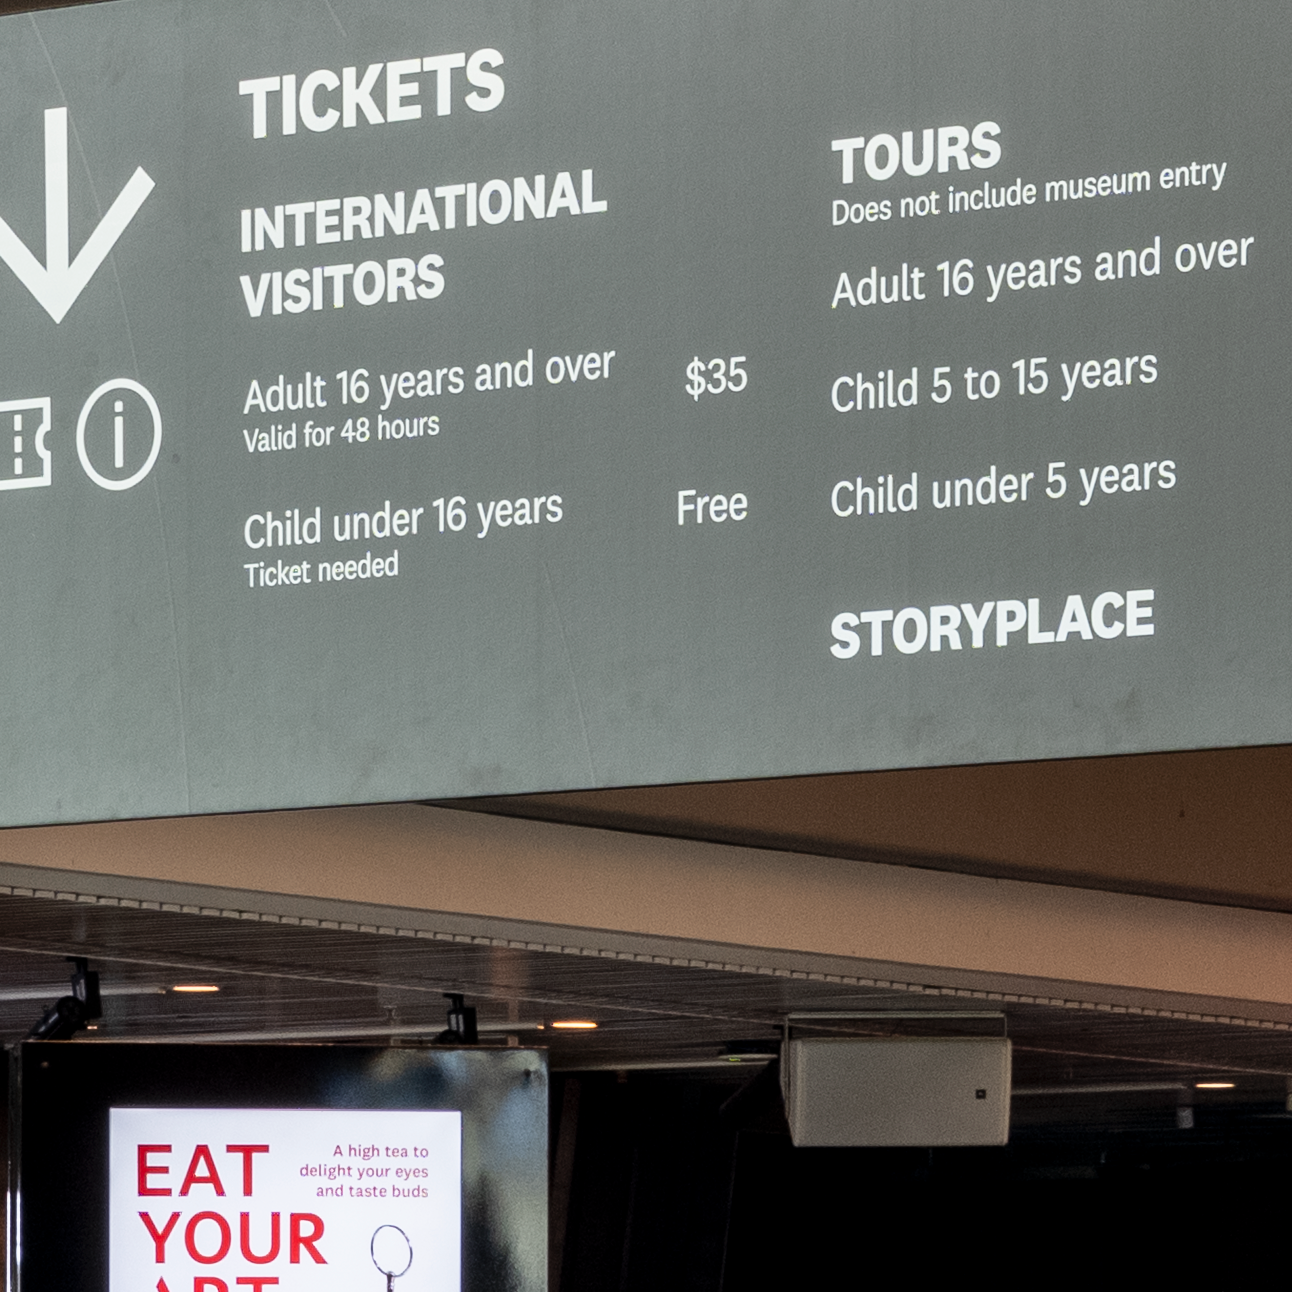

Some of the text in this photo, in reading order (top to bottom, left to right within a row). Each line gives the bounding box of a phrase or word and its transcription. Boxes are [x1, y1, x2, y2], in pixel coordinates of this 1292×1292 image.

[238, 47, 505, 139] TICKETS
[831, 121, 1002, 184] TOURS
[240, 168, 608, 253] INTERNATIONAL
[832, 161, 1228, 226] Does not include museum entry
[239, 253, 445, 318] VISITORS
[831, 235, 1255, 309] Adult 16 years and over
[243, 348, 616, 415] Adult 16 years and over
[685, 355, 748, 402] $35
[831, 354, 1158, 413] Child 5 to 15 years
[242, 413, 440, 453] Valid for 48 hours
[677, 489, 748, 526] Free
[831, 459, 1177, 517] Child under 5 years
[244, 494, 563, 549] Child under 16 years
[243, 549, 399, 588] Ticket needed
[829, 588, 1155, 659] STORYPLACE
[136, 1143, 270, 1197] EAT
[299, 1163, 429, 1181] delight your eyes
[333, 1144, 429, 1161] A high tea to
[316, 1184, 429, 1198] and taste buds
[137, 1210, 328, 1265] YOUR
